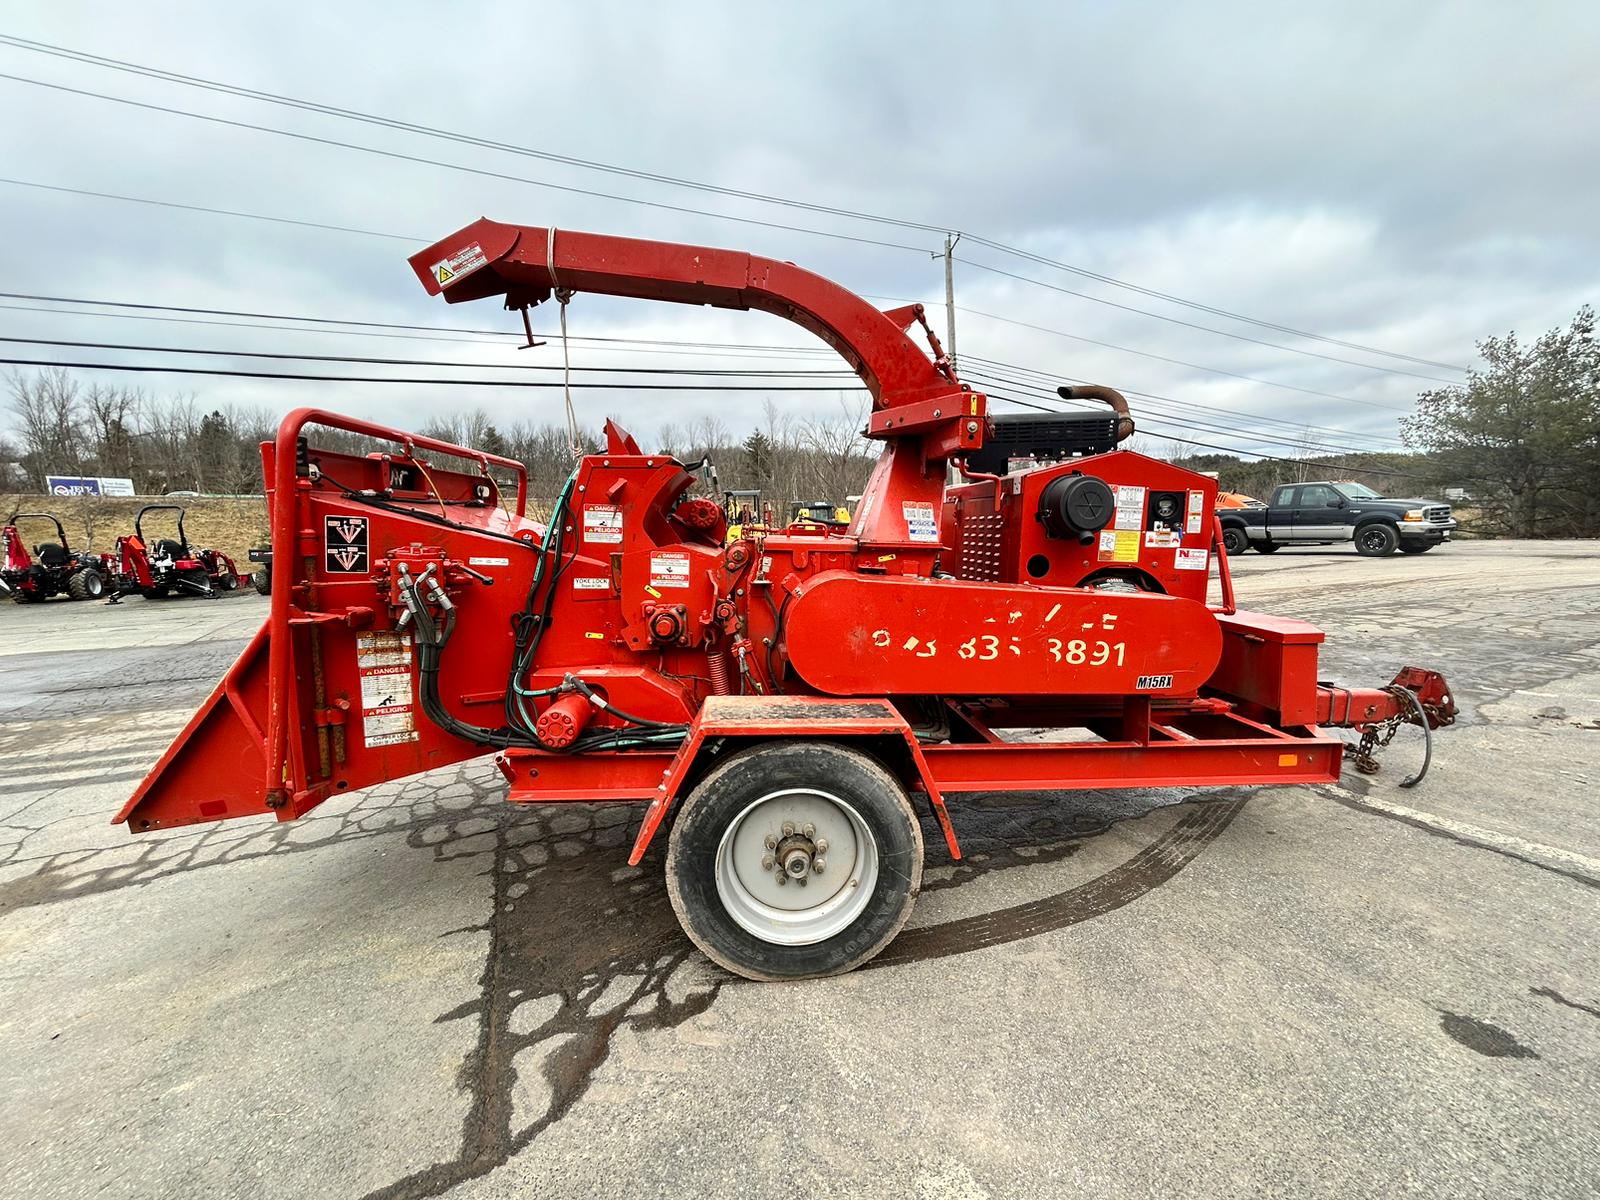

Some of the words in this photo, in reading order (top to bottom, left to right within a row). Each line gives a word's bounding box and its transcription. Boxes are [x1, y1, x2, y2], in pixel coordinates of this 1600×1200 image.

[1047, 638, 1126, 667] 3891
[373, 666, 406, 675] DANGER
[1137, 675, 1173, 688] M15RX
[376, 705, 408, 715] PELIGRO
